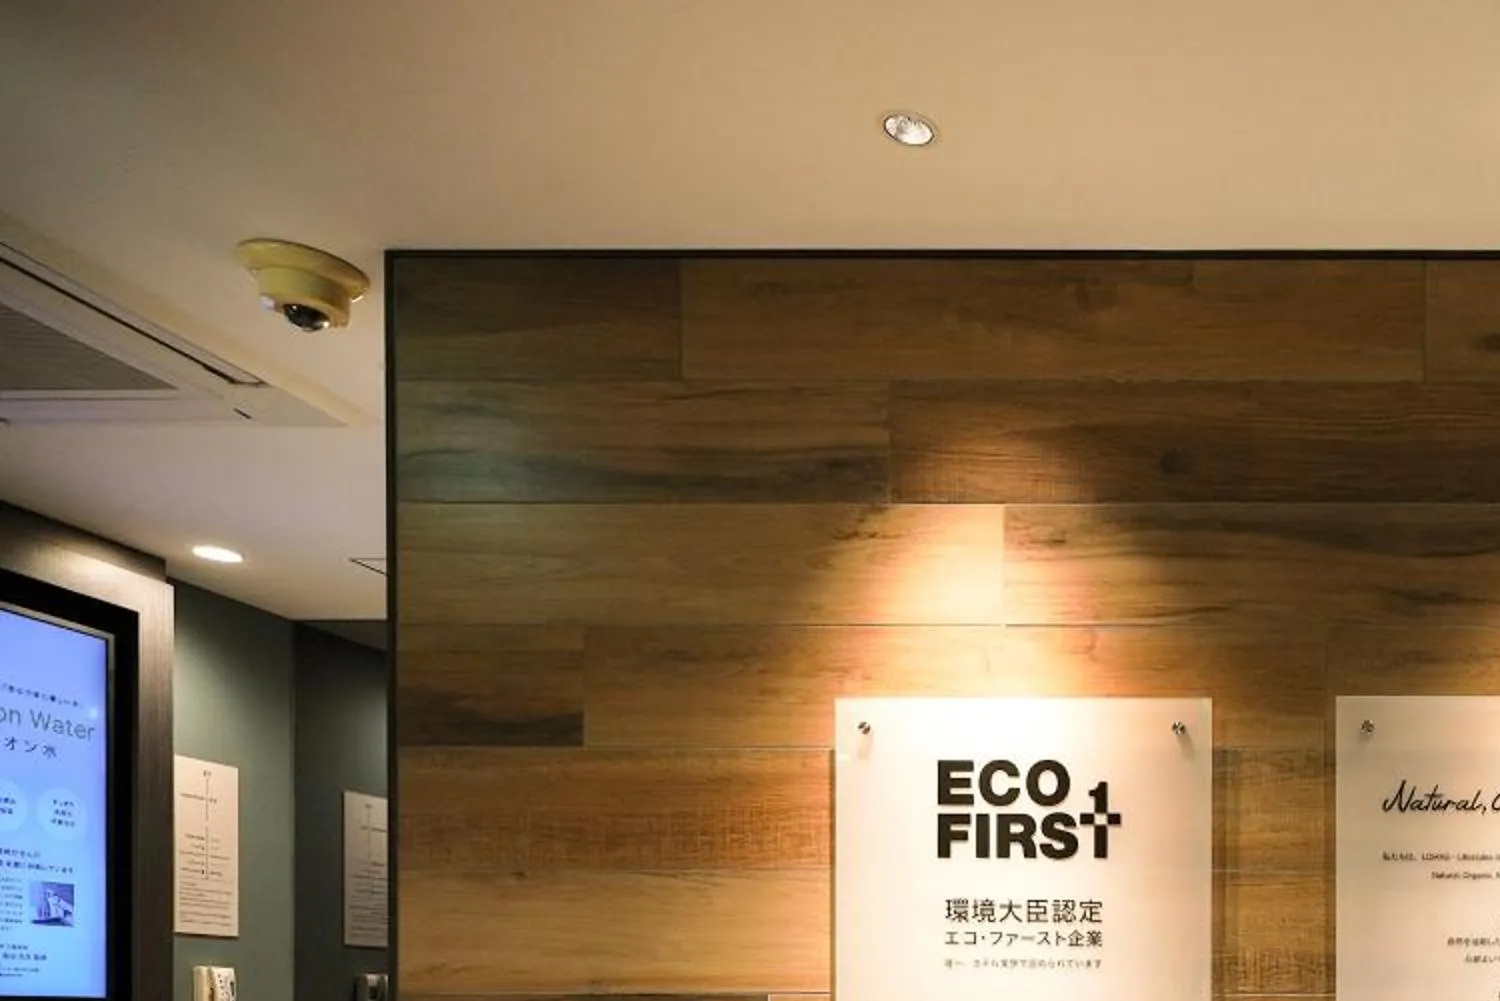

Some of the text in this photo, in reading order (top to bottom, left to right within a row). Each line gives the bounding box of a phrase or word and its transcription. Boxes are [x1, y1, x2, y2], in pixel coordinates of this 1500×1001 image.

[29, 708, 96, 743] Water
[937, 759, 1071, 807] ECO
[1382, 779, 1489, 815] Natural,
[945, 898, 1103, 925] 環境大臣認定
